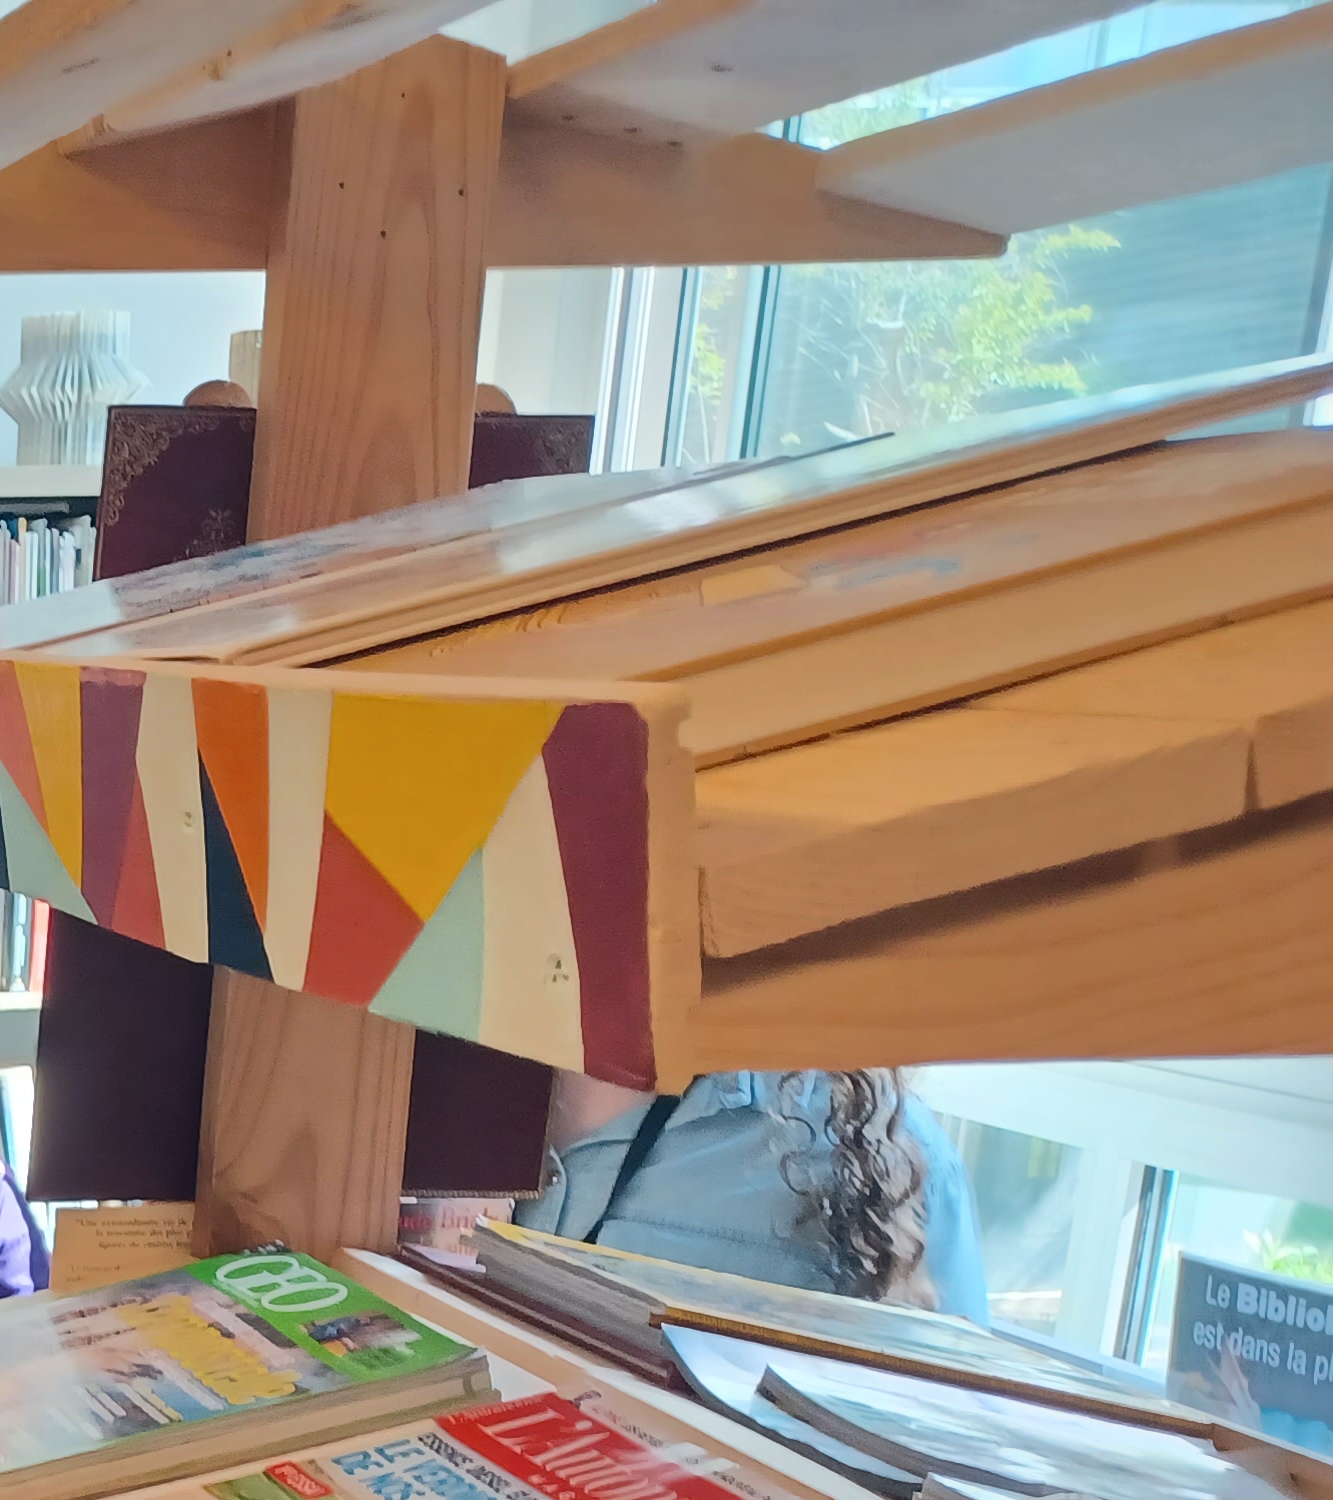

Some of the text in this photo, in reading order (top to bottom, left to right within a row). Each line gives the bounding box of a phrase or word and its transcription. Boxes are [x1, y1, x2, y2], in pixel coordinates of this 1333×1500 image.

[215, 1255, 349, 1312] GEO
[1205, 1275, 1231, 1309] Le
[1193, 1321, 1224, 1351] est
[1227, 1327, 1281, 1368] dans
[1287, 1342, 1307, 1376] la
